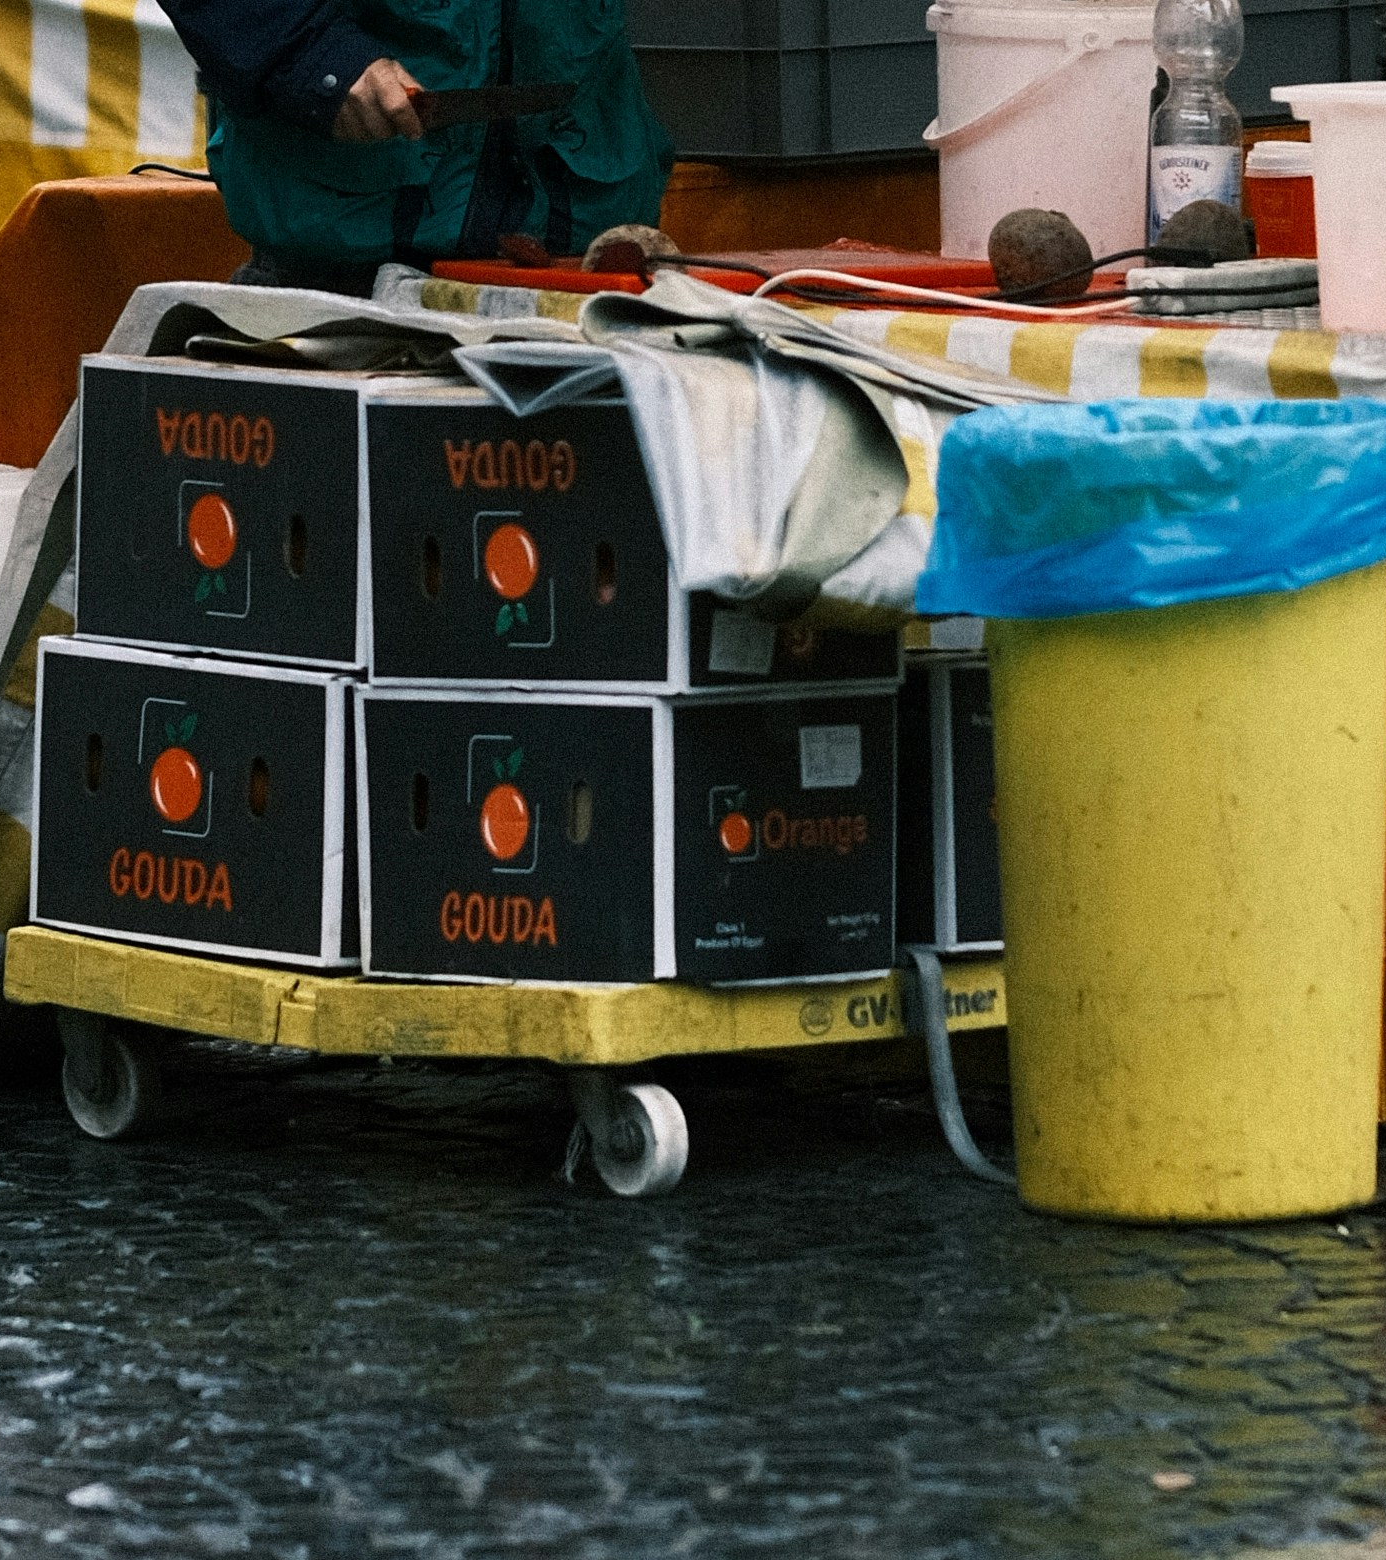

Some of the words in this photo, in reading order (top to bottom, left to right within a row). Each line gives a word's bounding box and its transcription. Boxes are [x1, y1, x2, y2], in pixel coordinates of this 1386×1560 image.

[156, 406, 275, 469] GOUDA
[443, 438, 576, 492] GOUDA
[764, 809, 868, 856] Orange
[109, 846, 233, 913] GOUDA
[439, 889, 558, 947] GOUDA
[847, 989, 997, 1027] GV-tner
